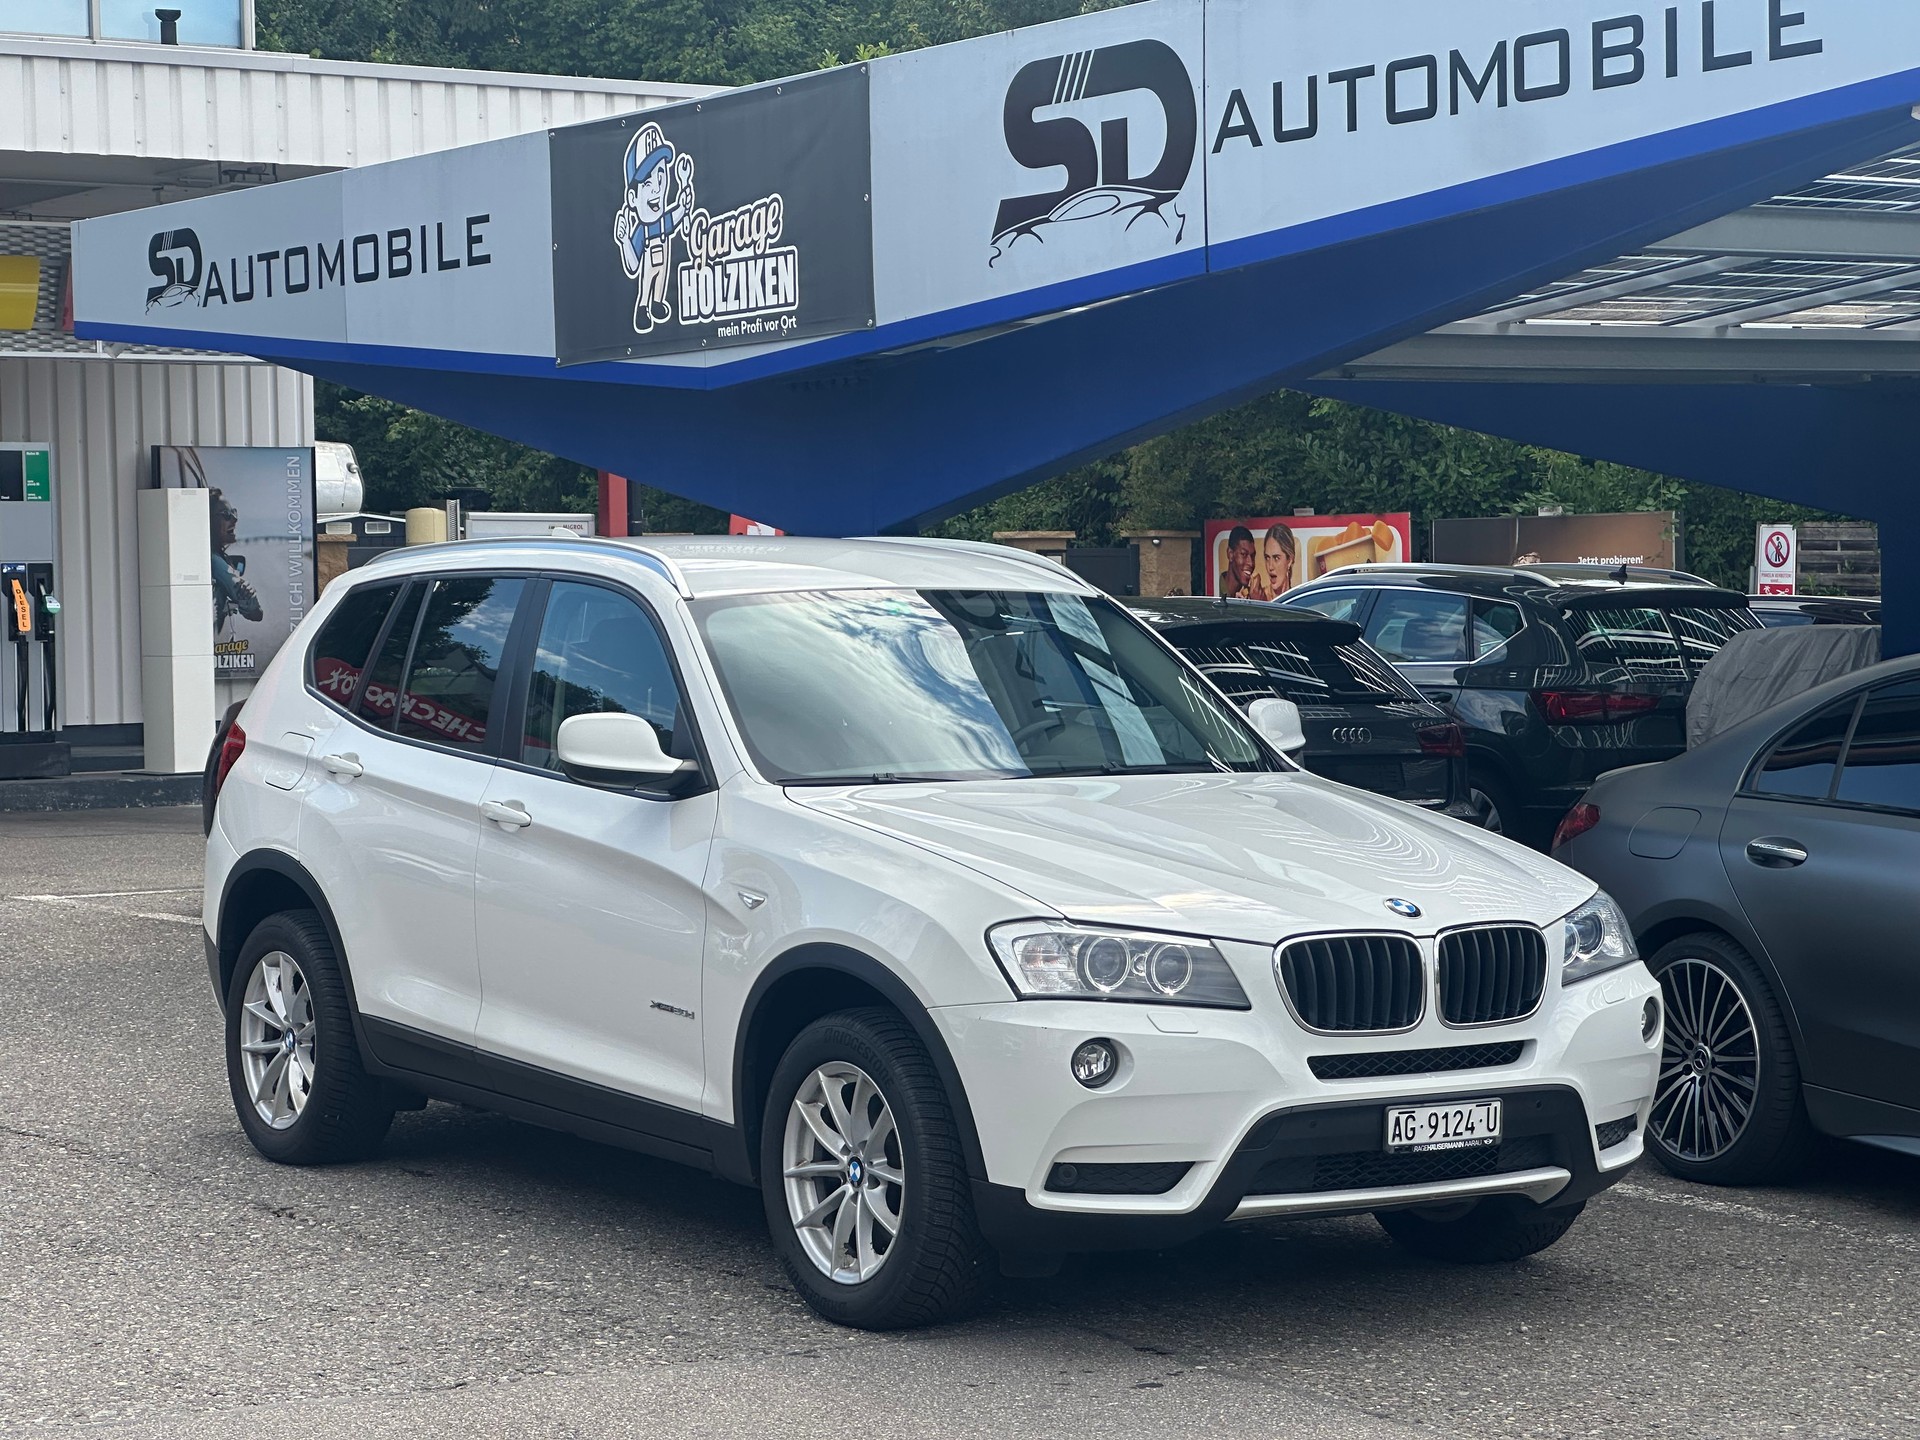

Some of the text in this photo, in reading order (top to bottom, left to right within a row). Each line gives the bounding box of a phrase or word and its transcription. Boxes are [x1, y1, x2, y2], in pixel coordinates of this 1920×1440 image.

[988, 0, 1823, 246] SD AUTOMOBILE
[202, 213, 492, 308] AUTOMOBILE
[690, 196, 782, 272] Garage
[681, 253, 795, 319] HOLZIKEN
[717, 315, 797, 338] mein Profi vor Ort
[287, 455, 303, 634] ZLICH WILLKOMMEN
[1577, 555, 1644, 565] Jetzt probieren!
[16, 588, 27, 628] DIESEL
[214, 640, 249, 654] arage
[214, 654, 255, 669] LZIKEN
